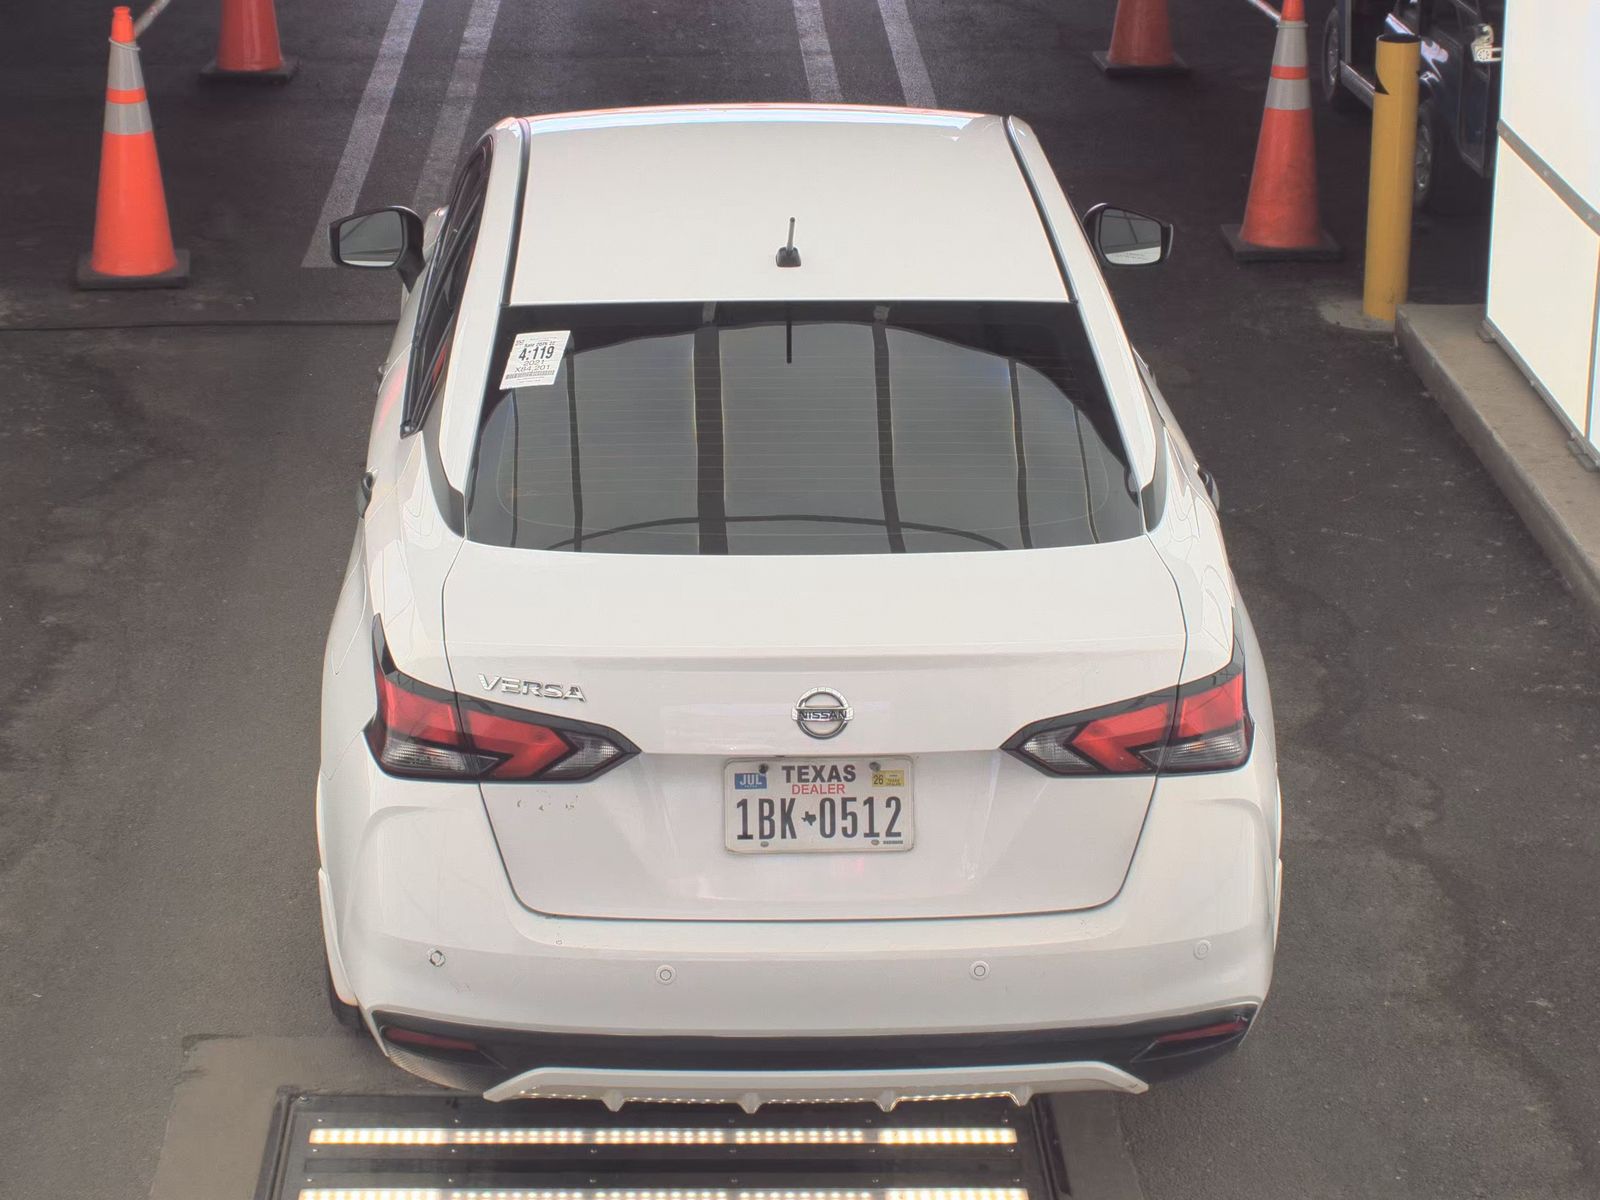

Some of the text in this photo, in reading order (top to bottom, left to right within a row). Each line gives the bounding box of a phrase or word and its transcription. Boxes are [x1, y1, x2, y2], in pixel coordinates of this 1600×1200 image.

[518, 345, 555, 361] 4:119
[478, 673, 586, 702] VERSA
[799, 710, 848, 720] NISSAN
[739, 774, 763, 786] JUL
[781, 764, 856, 784] TEXAS
[873, 774, 885, 785] 26
[791, 783, 846, 795] DEALER
